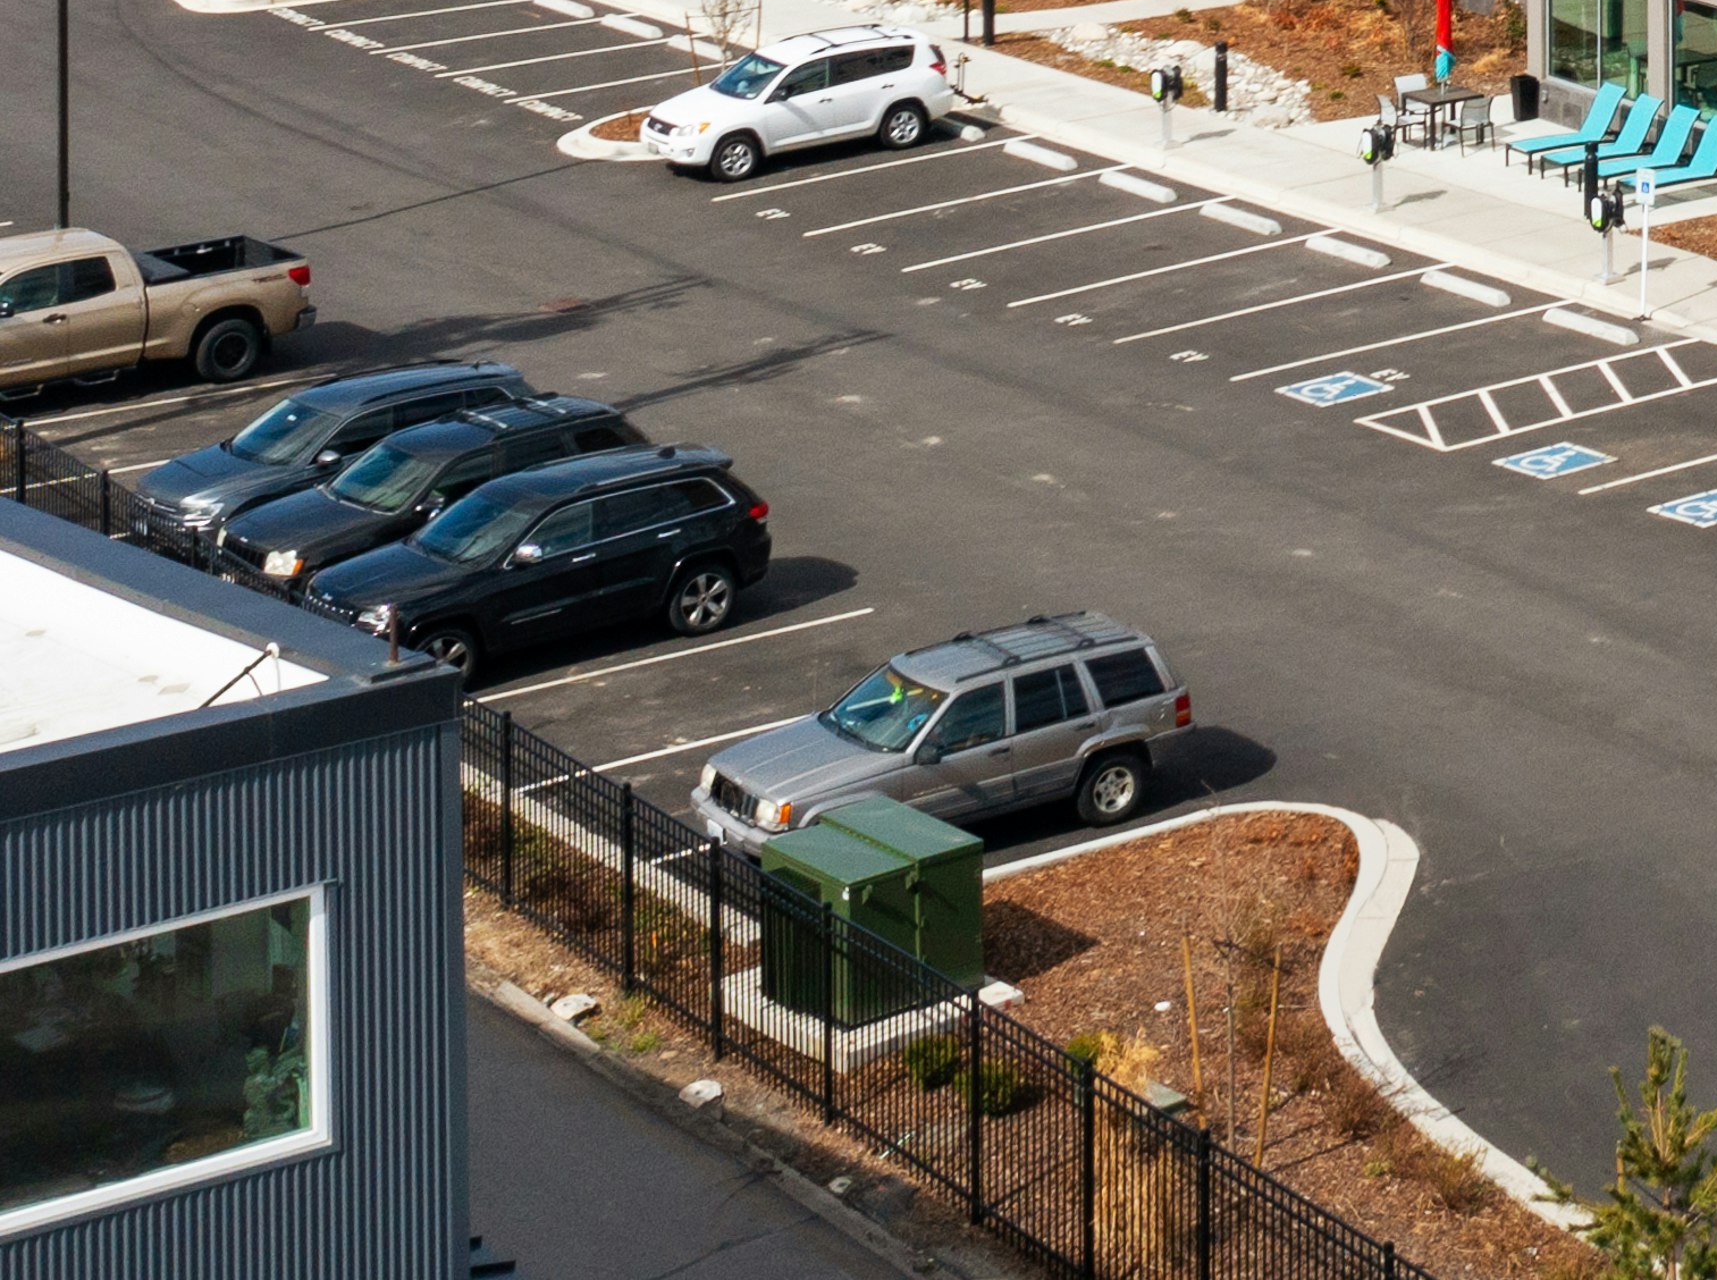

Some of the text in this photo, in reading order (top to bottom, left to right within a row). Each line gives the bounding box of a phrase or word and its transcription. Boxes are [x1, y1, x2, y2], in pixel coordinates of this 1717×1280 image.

[755, 207, 791, 220] EV
[850, 242, 887, 255] EV
[950, 277, 988, 291] EV
[1054, 312, 1093, 326] EV
[1169, 349, 1209, 363] EV
[1369, 367, 1411, 382] EV
